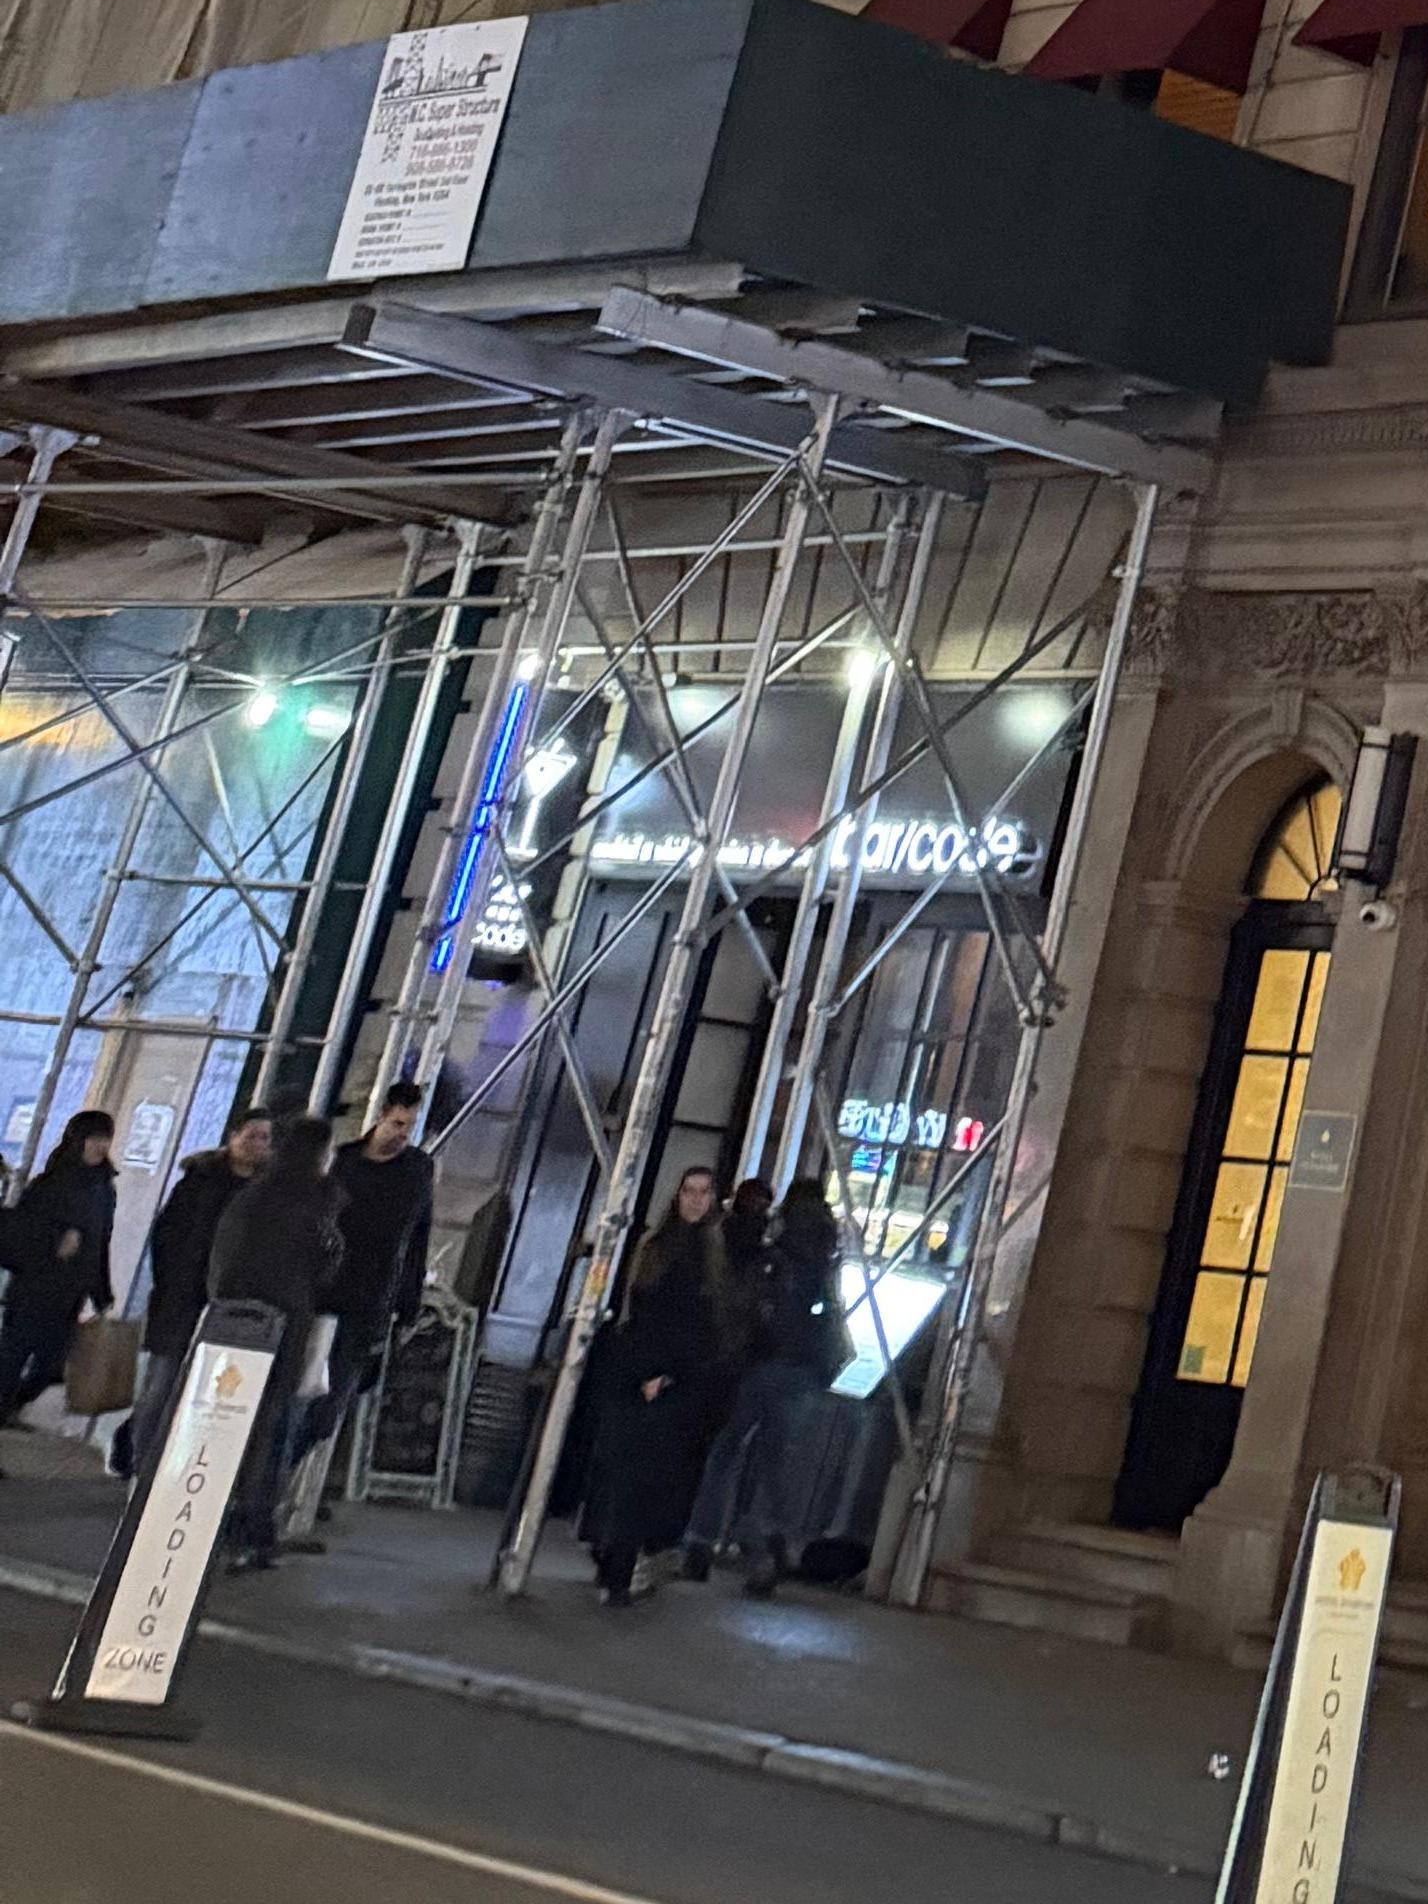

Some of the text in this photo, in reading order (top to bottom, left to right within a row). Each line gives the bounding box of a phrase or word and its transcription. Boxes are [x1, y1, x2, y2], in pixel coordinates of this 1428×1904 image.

[139, 1444, 208, 1637] LOADING
[103, 1647, 168, 1674] ZONE
[1293, 1653, 1341, 1904] LOADING
